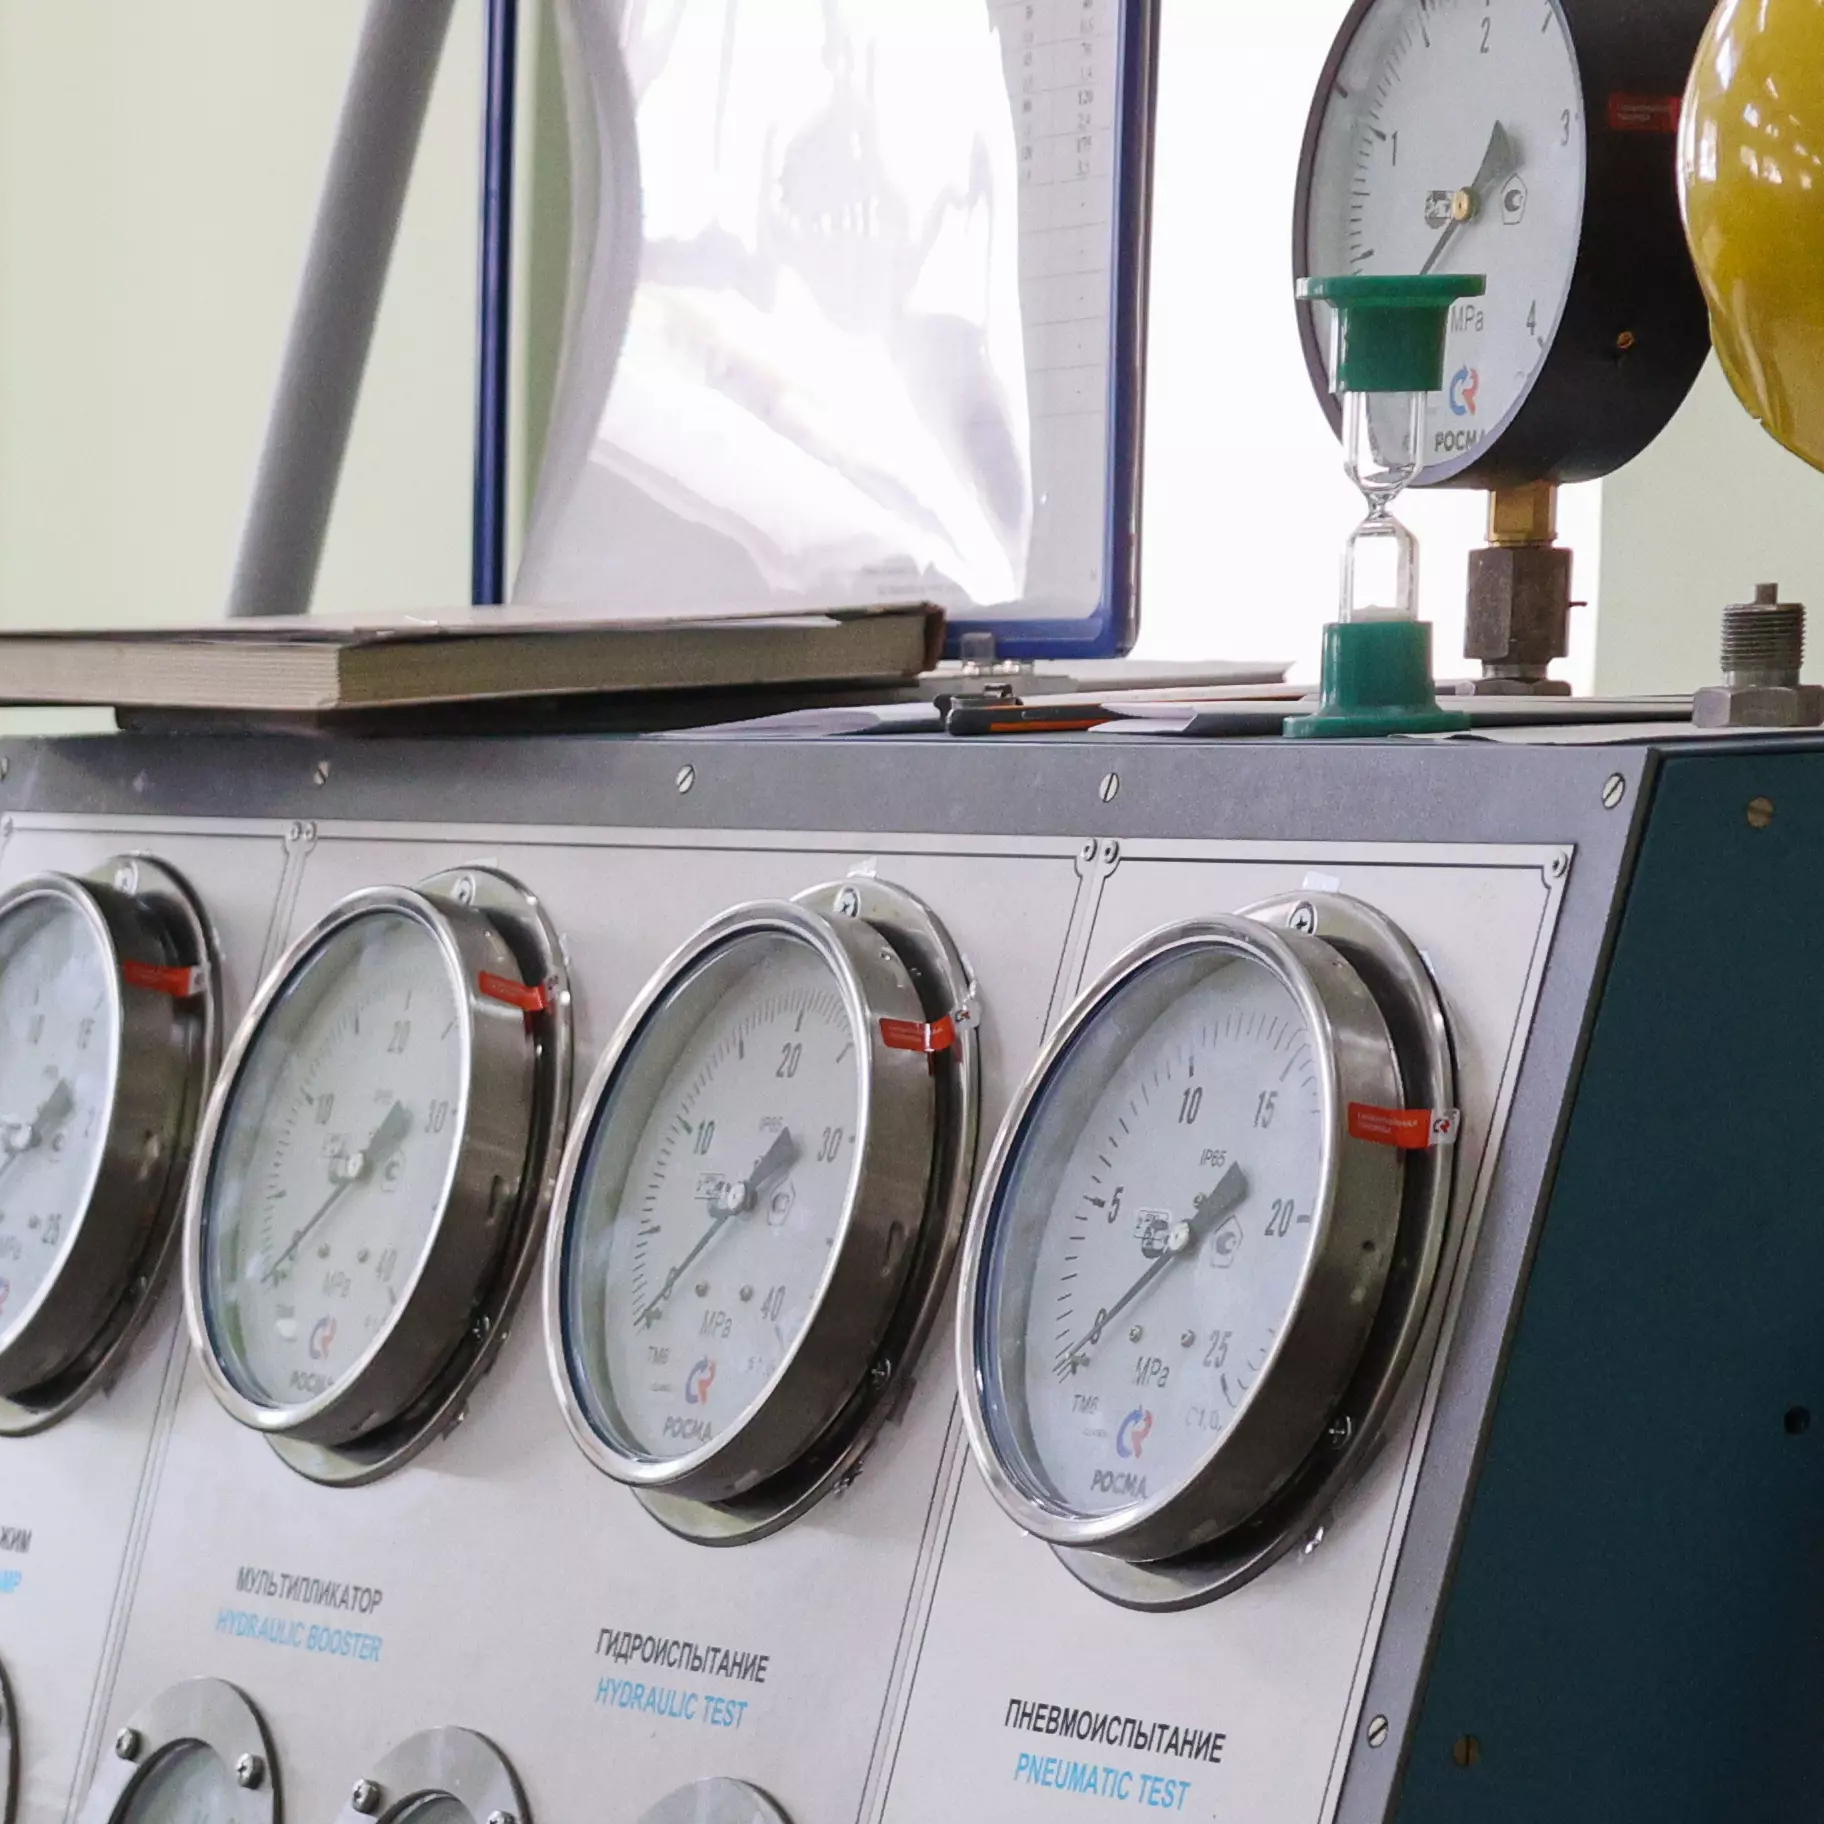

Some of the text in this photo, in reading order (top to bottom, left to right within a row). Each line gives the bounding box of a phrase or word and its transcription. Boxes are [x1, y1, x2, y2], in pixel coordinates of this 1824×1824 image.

[1479, 15, 1491, 55] 2
[1559, 108, 1572, 149] 3
[1389, 129, 1399, 167] 1
[1450, 304, 1485, 333] MPa
[1525, 299, 1537, 336] 4
[386, 1018, 412, 1055] 20
[776, 1042, 803, 1080] 20
[315, 1091, 336, 1128] 10
[1178, 1086, 1203, 1124] 10
[1253, 1089, 1278, 1128] 15
[693, 1118, 716, 1156] 10
[817, 1125, 842, 1164] 30
[1108, 1186, 1125, 1223] 5
[1263, 1198, 1295, 1237] 20
[760, 1284, 786, 1322] 40
[700, 1308, 732, 1339] MPa
[1202, 1328, 1232, 1369] 25
[1135, 1355, 1170, 1389] MPa
[662, 1415, 713, 1442] РОСМА
[1090, 1468, 1149, 1499] РОСМА
[236, 1565, 384, 1615] МУЛЬТИПЛИКАТОР
[214, 1608, 384, 1662] HYDRAULIC BOOSTER
[594, 1627, 771, 1683] ГИДРОИСПЫТАНИЕ
[595, 1675, 749, 1729] HYDRAULIC TEST
[1004, 1697, 1227, 1764] ПНЕВМОИСПЫТАНИЕ
[1013, 1752, 1192, 1811] PNEUMATIC TEST
